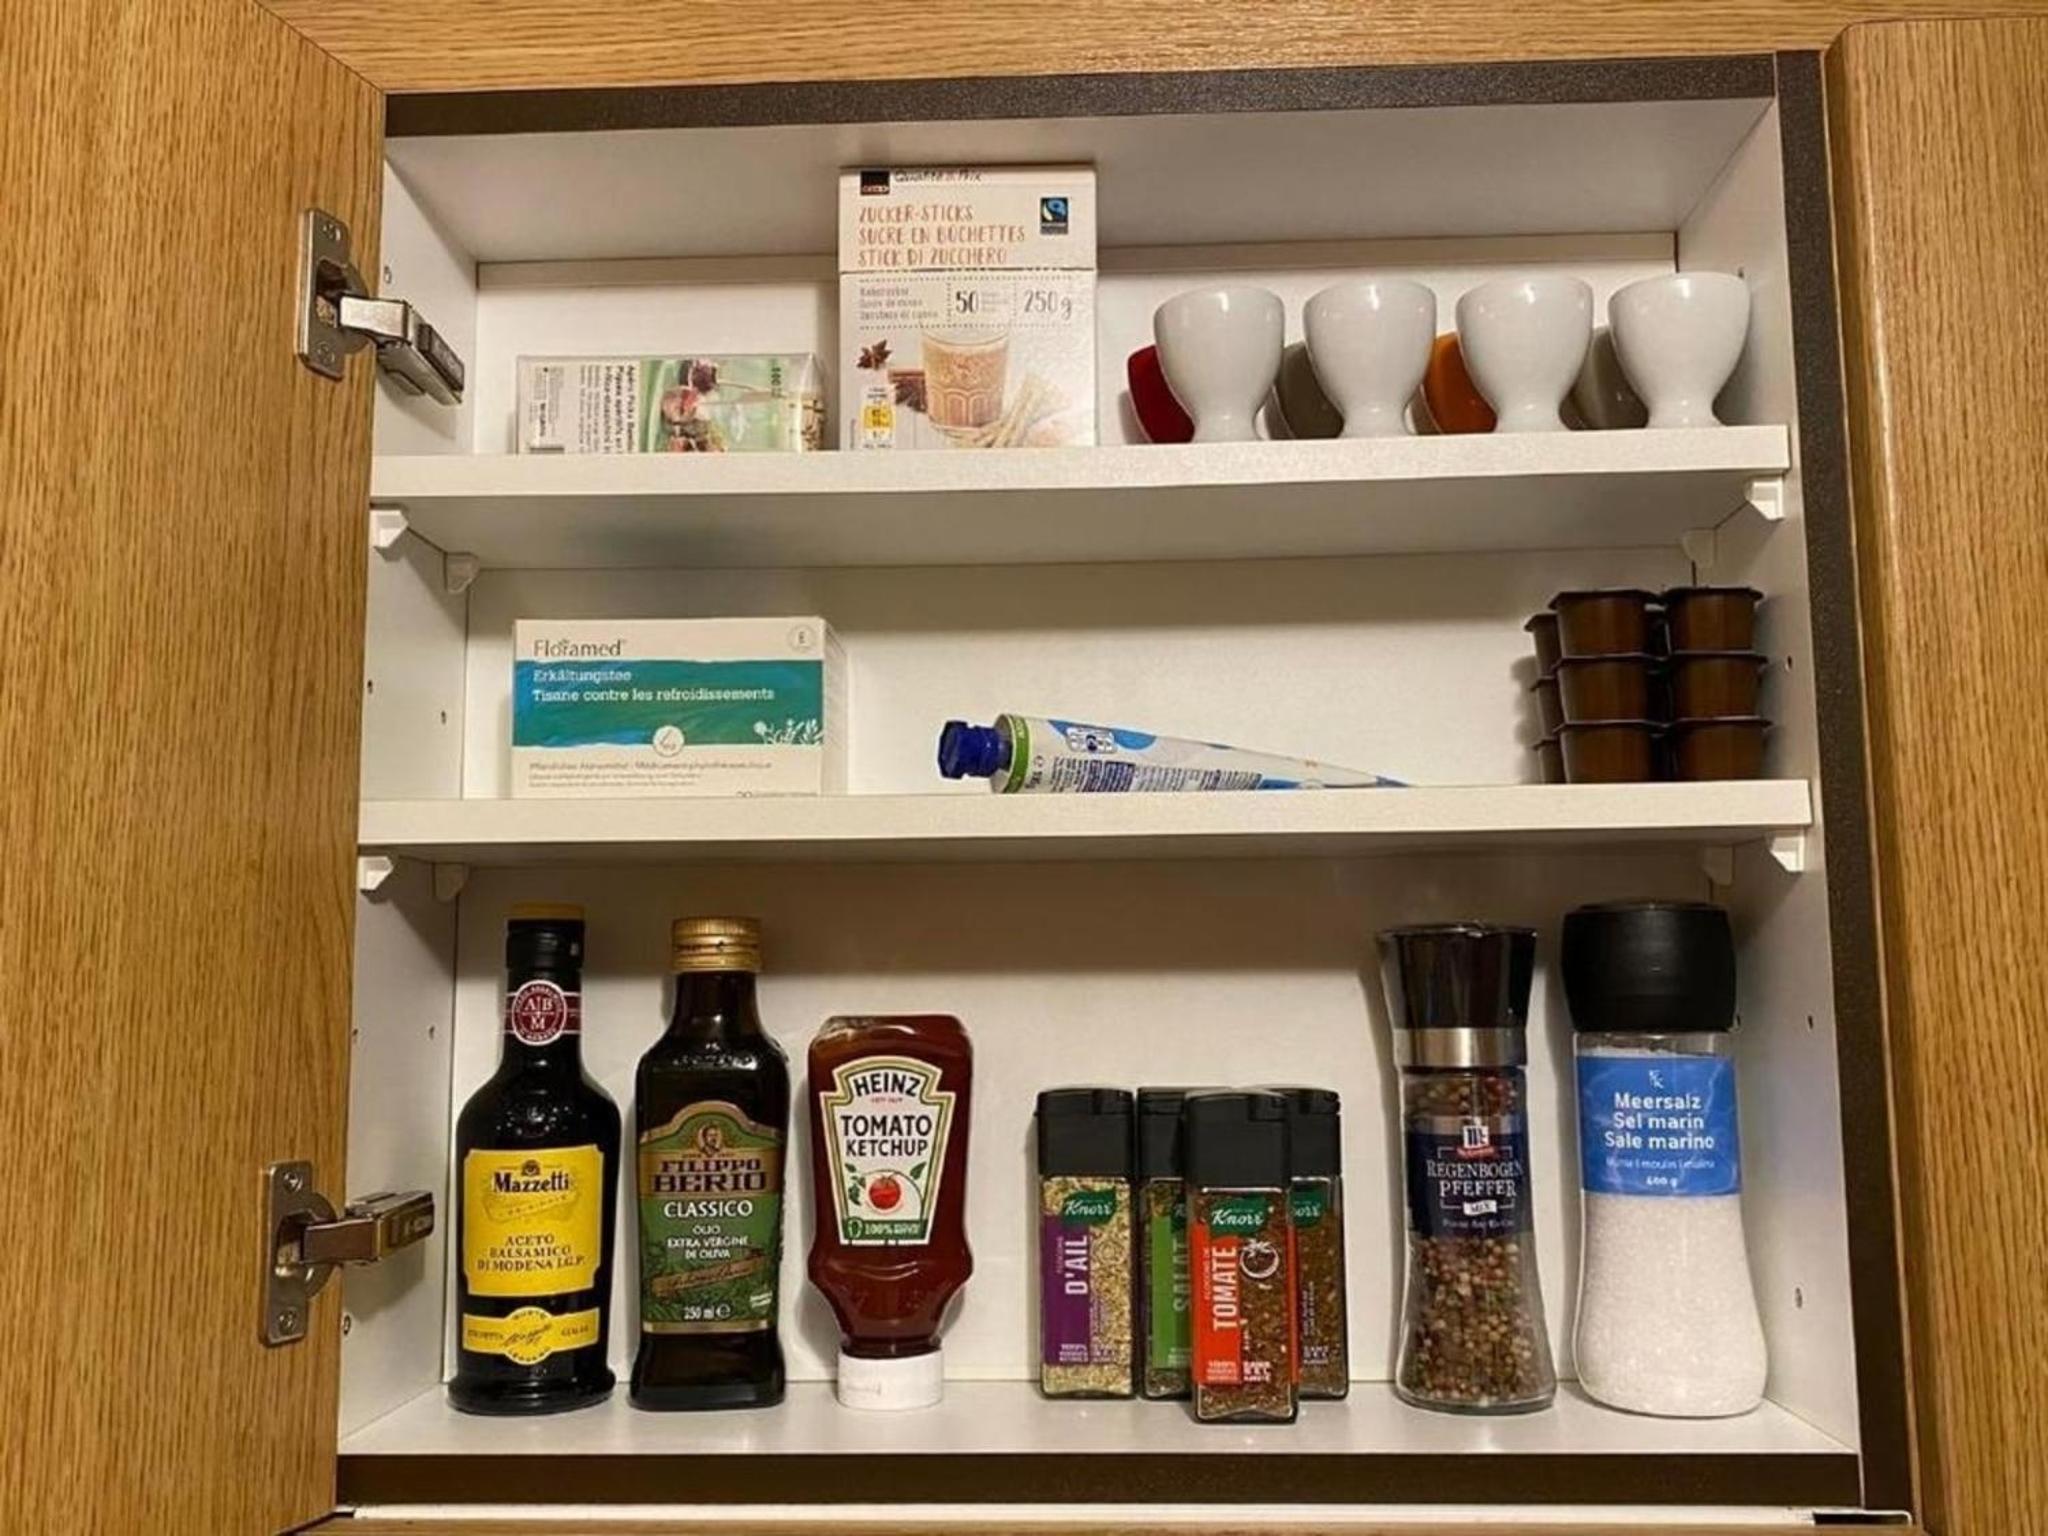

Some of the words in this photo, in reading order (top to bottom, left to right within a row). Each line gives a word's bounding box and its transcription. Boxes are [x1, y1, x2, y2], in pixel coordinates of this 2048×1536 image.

[859, 204, 973, 223] ZUCKER-STICKS
[859, 227, 906, 246] SUCRE
[911, 226, 931, 244] EN
[858, 248, 901, 267] STICK
[907, 248, 923, 266] DI
[930, 247, 1007, 265] ZUCCHERO
[956, 291, 979, 314] 50
[1024, 290, 1058, 314] 250
[1060, 298, 1074, 321] g
[533, 639, 622, 657] Floramed
[533, 668, 632, 685] Erkältungstee
[532, 689, 580, 701] Tisane
[583, 688, 630, 701] contre
[633, 687, 653, 701] les
[657, 687, 775, 701] refroidissements
[853, 1072, 921, 1097] HEINZ
[1614, 1092, 1702, 1109] Meersalz
[840, 1114, 933, 1137] TOMATO
[1613, 1111, 1642, 1129] Sel
[1647, 1112, 1705, 1130] marin
[846, 1138, 928, 1157] KETCHUP
[1604, 1131, 1642, 1149] Sale
[1648, 1131, 1715, 1150] marino
[661, 1160, 761, 1173] FILIPPO
[1427, 1159, 1523, 1178] REGENBOGEN
[494, 1171, 569, 1194] Mazzetti
[655, 1173, 765, 1192] BERIO
[1439, 1179, 1516, 1197] PFEFFER
[664, 1200, 753, 1218] CLASSICO
[1065, 1200, 1113, 1216] Knorr
[1211, 1208, 1265, 1225] Knorr
[692, 1225, 720, 1235] OLIO
[505, 1234, 554, 1247] ACETO
[667, 1237, 701, 1248] EXTRA
[703, 1235, 748, 1248] VERGINE
[490, 1244, 572, 1259] BALSAMICO
[699, 1248, 731, 1259] OLIVA
[477, 1259, 489, 1271] DI
[493, 1259, 554, 1272] MODENA
[1065, 1235, 1089, 1295] D'AIL
[1212, 1247, 1238, 1331] TOMATE
[683, 1306, 701, 1320] 250
